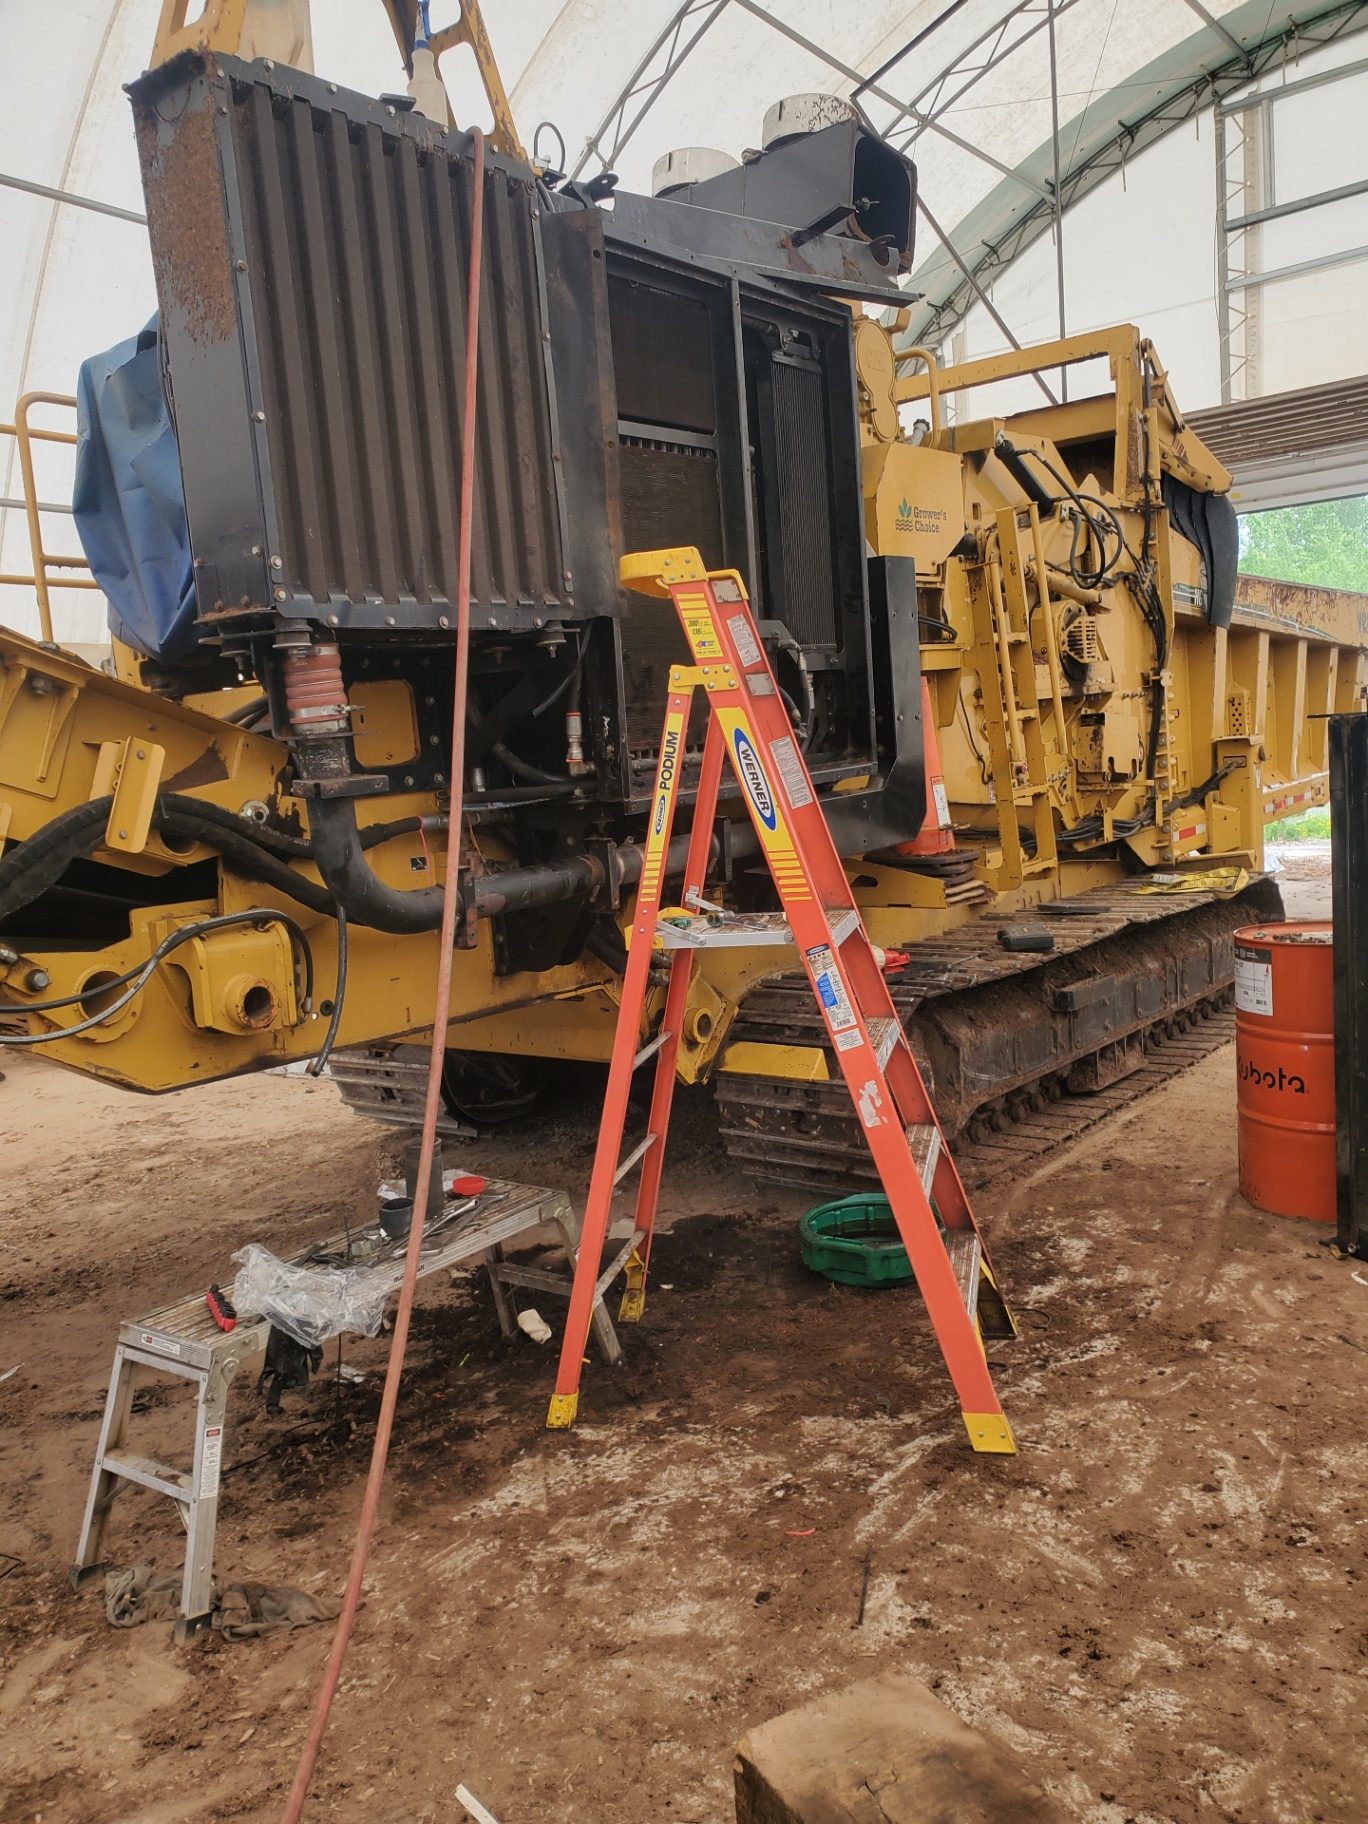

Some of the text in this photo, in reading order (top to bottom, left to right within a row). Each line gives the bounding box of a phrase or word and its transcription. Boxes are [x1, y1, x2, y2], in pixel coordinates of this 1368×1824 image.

[913, 506, 946, 520] Grower's
[914, 520, 939, 533] Choice
[659, 731, 679, 790] PODIUM
[740, 748, 770, 811] WERNER
